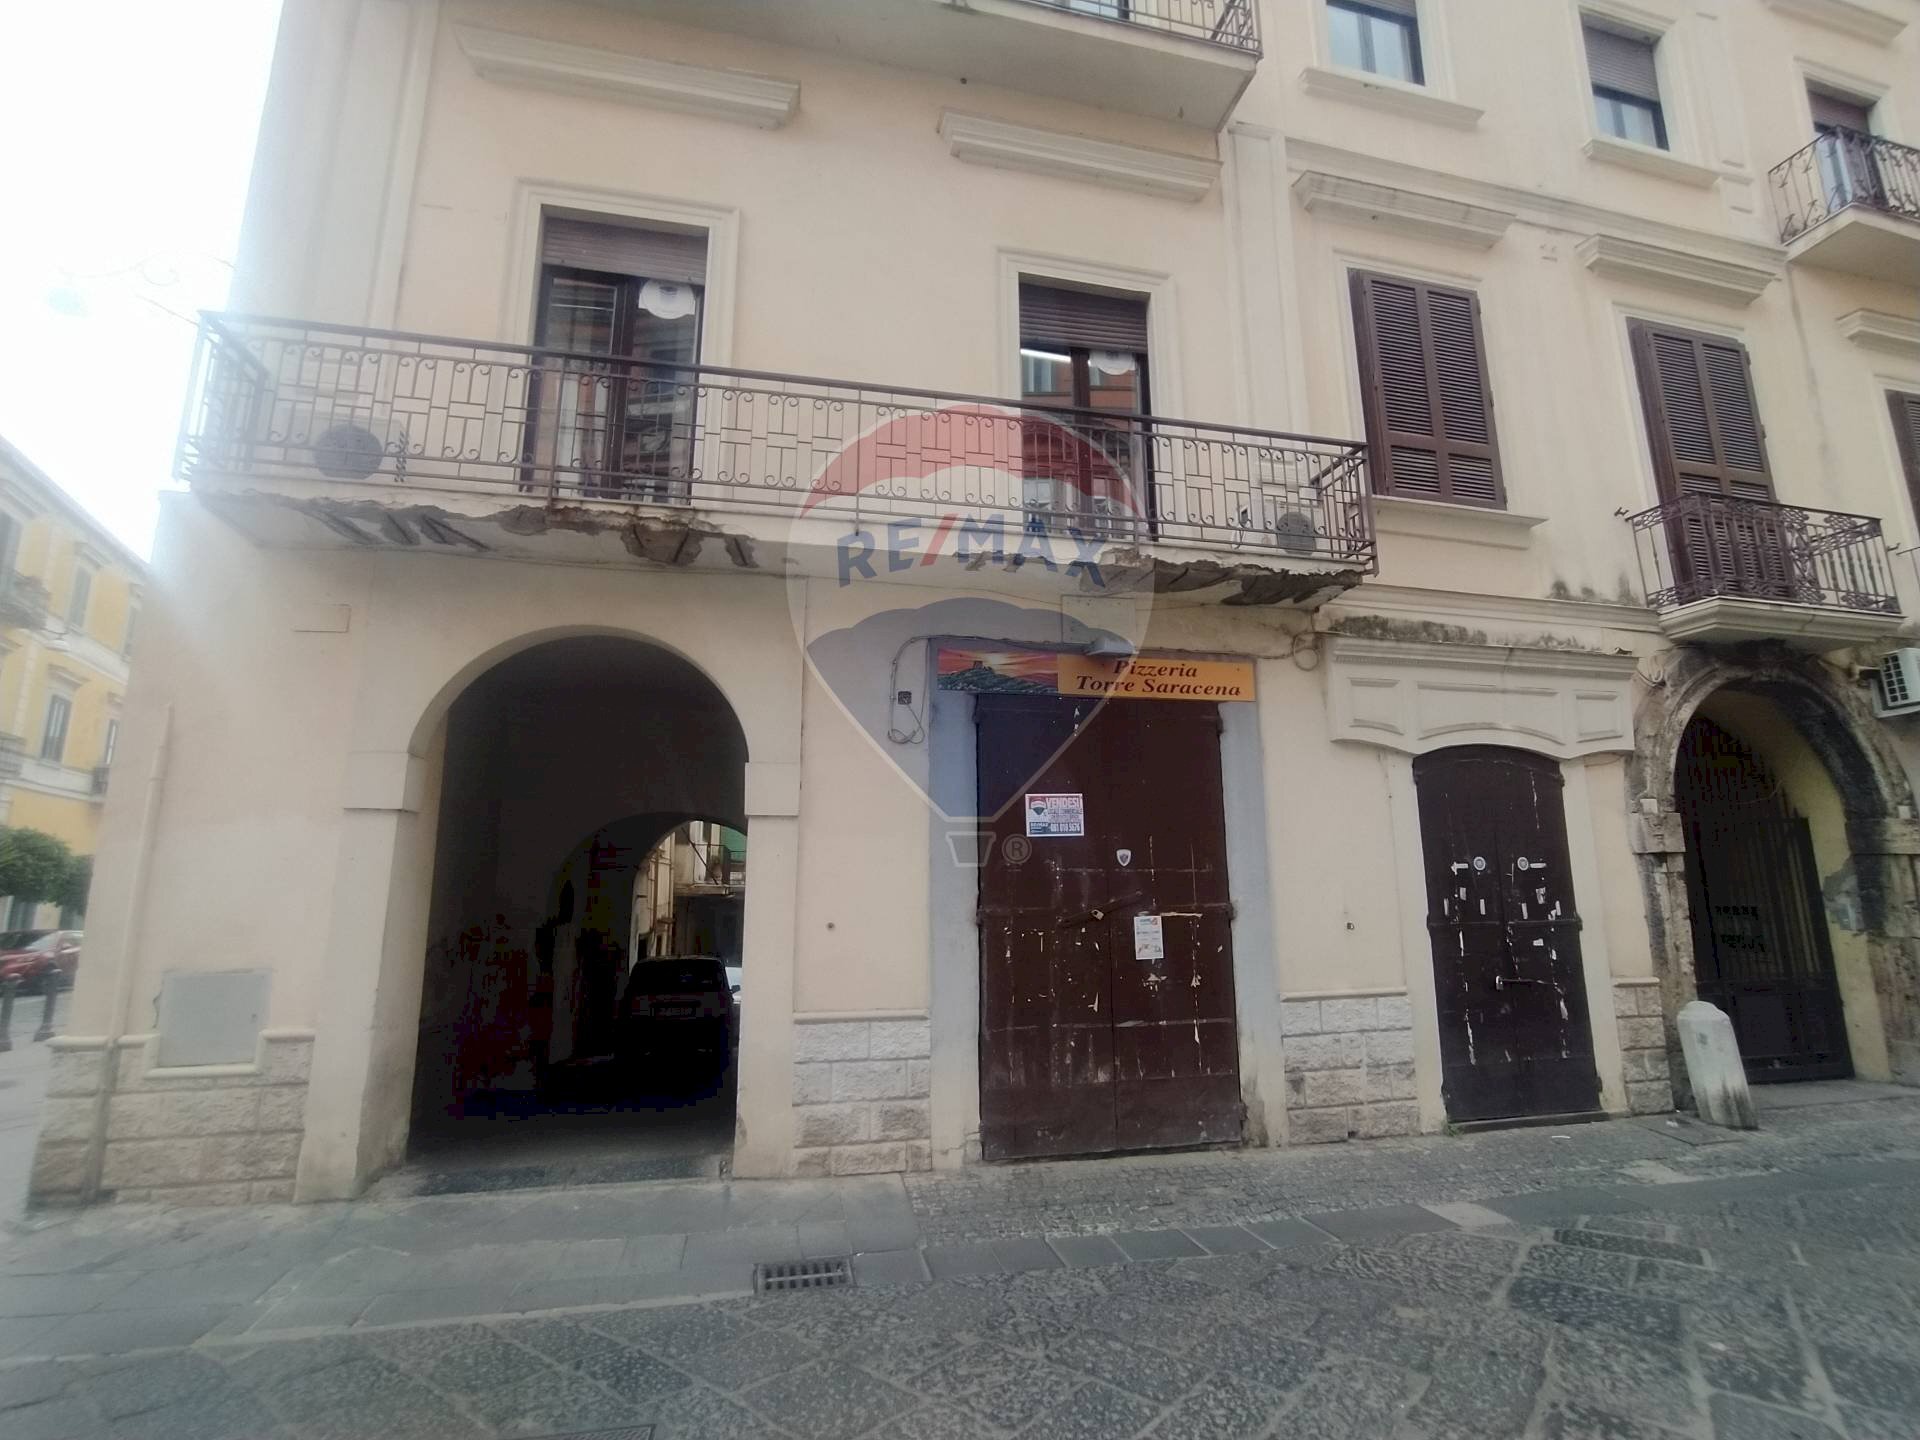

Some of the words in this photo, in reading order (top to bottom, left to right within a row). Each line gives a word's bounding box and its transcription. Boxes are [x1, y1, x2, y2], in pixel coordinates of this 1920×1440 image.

[1114, 660, 1198, 677] Pizzeria
[1077, 675, 1135, 692] Torre
[1142, 678, 1242, 697] Saracena
[1046, 797, 1080, 809] VENDESI
